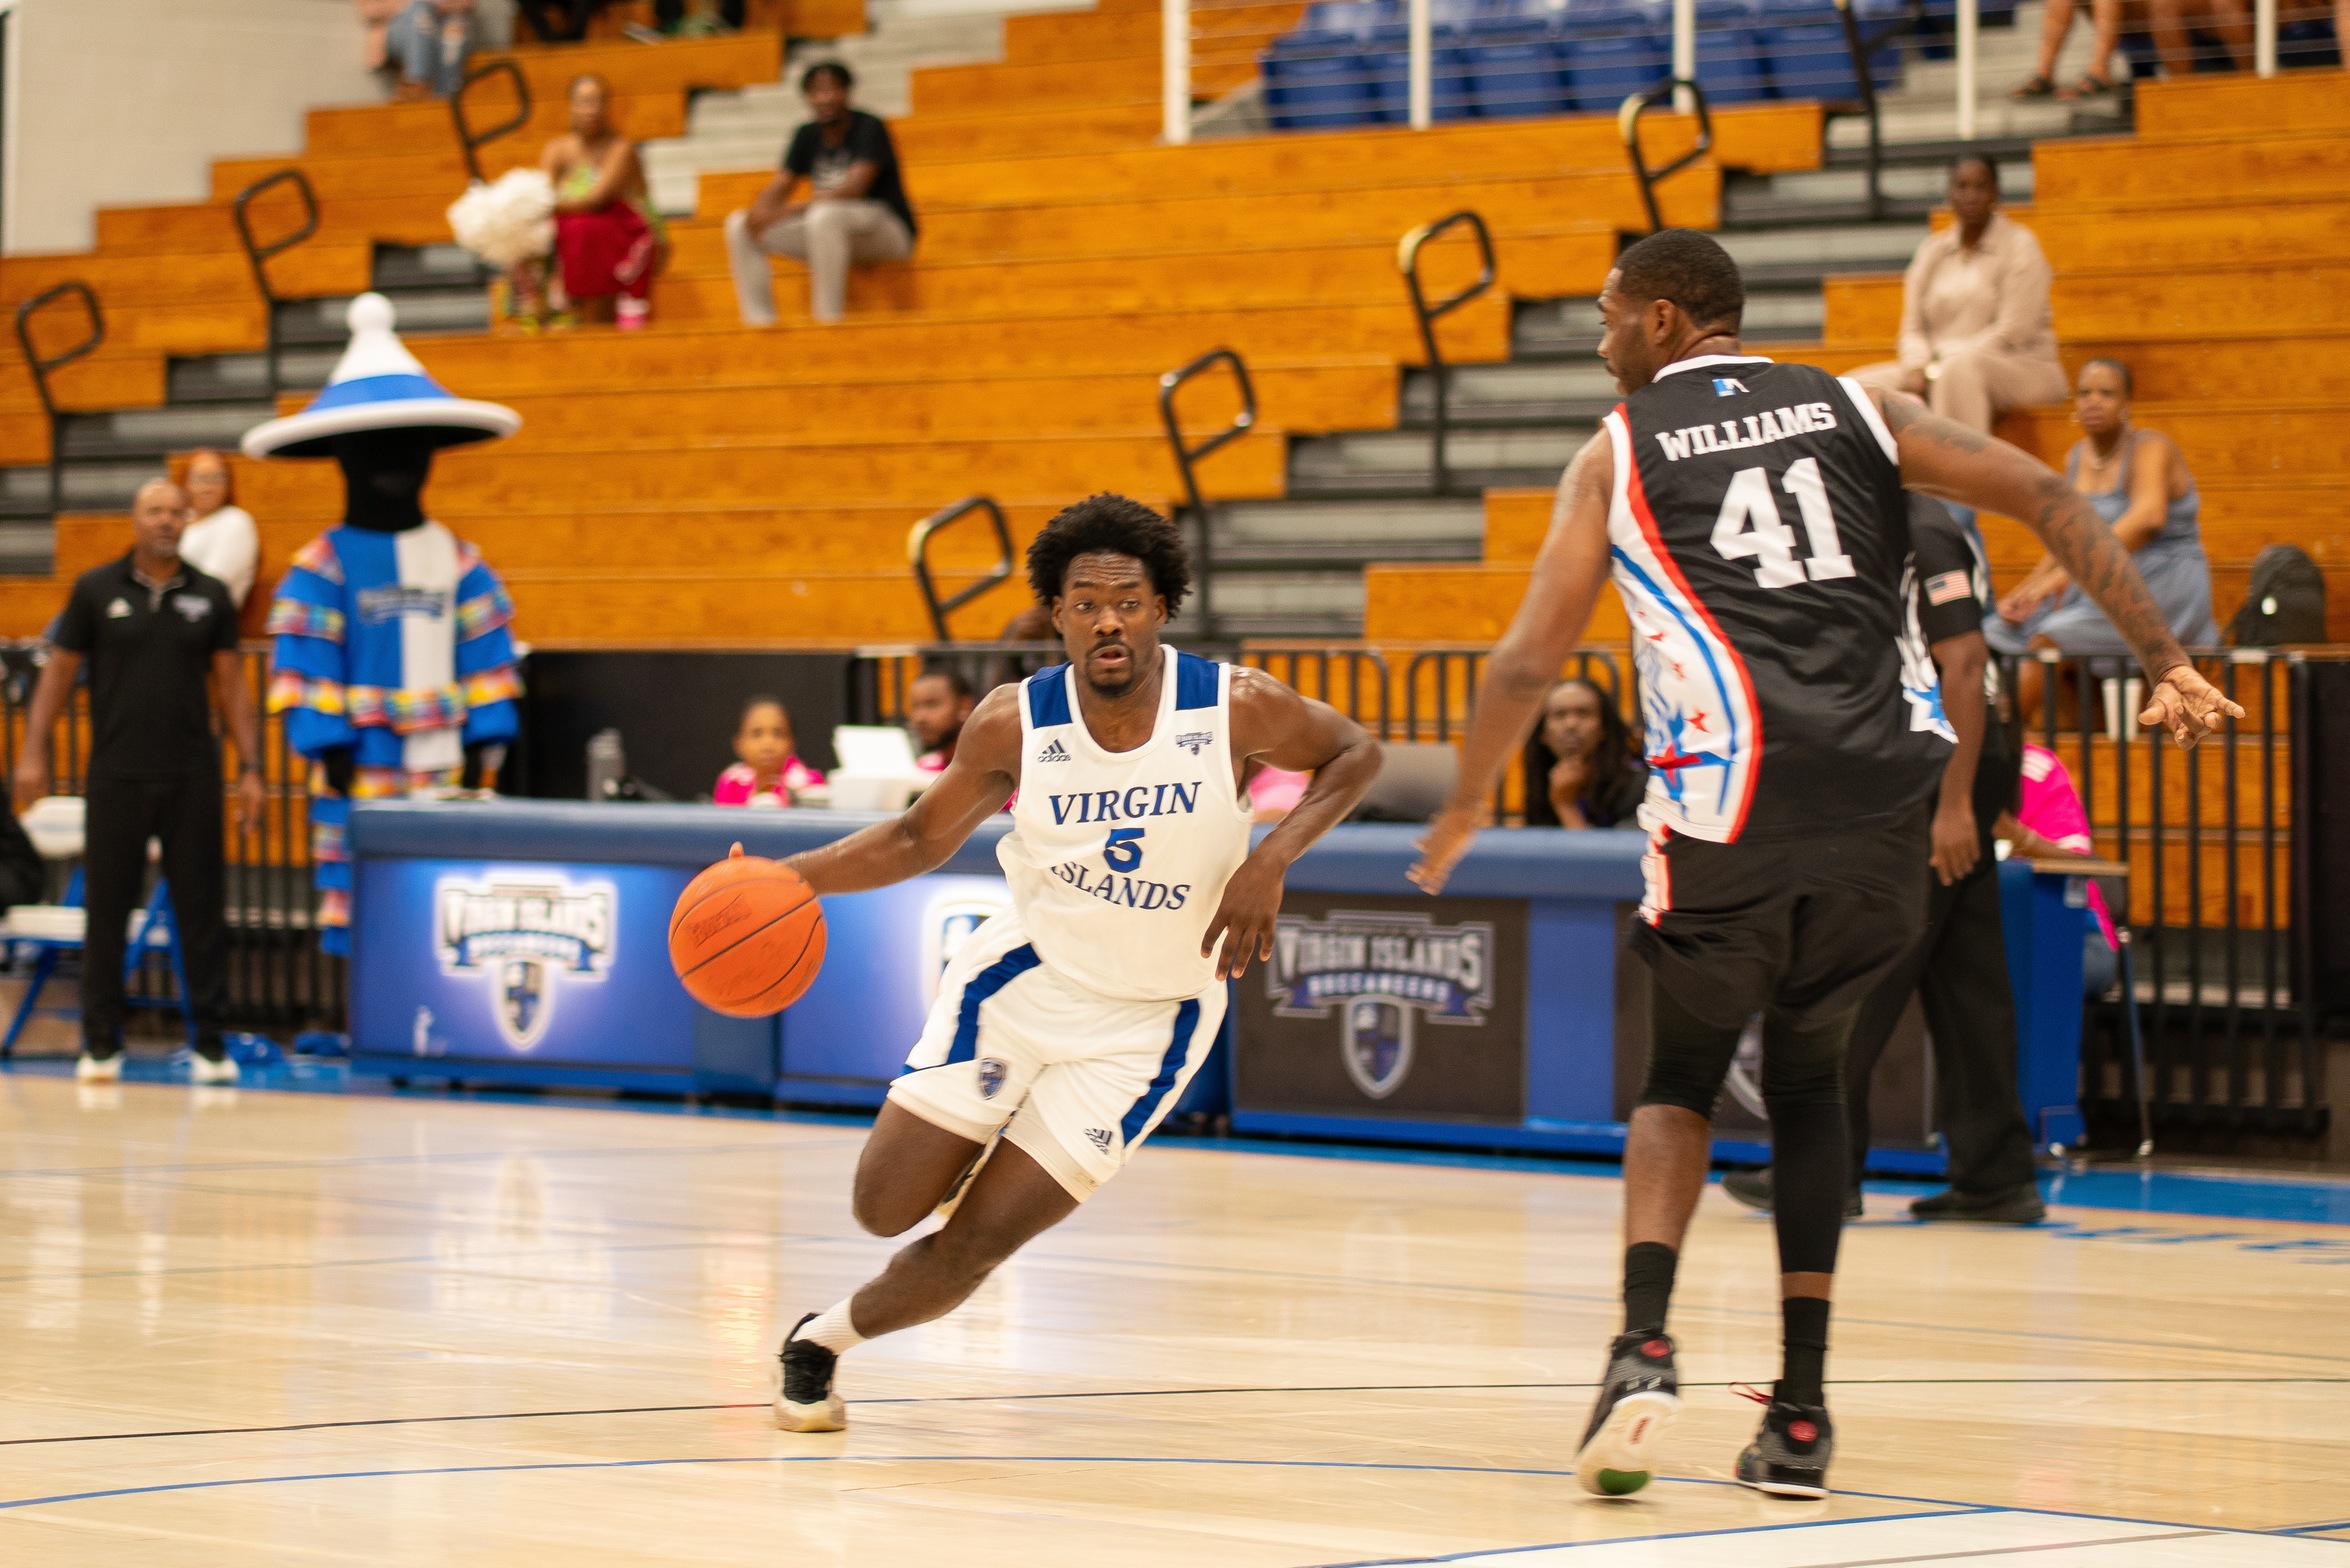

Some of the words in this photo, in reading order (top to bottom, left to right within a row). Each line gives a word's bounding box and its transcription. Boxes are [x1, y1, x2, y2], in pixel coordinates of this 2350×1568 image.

[1655, 402, 1837, 461] WILLIAMS
[1709, 457, 1856, 588] 41
[1037, 753, 1071, 763] adidas
[1049, 781, 1202, 825] VIRGIN
[1103, 828, 1145, 873] 5
